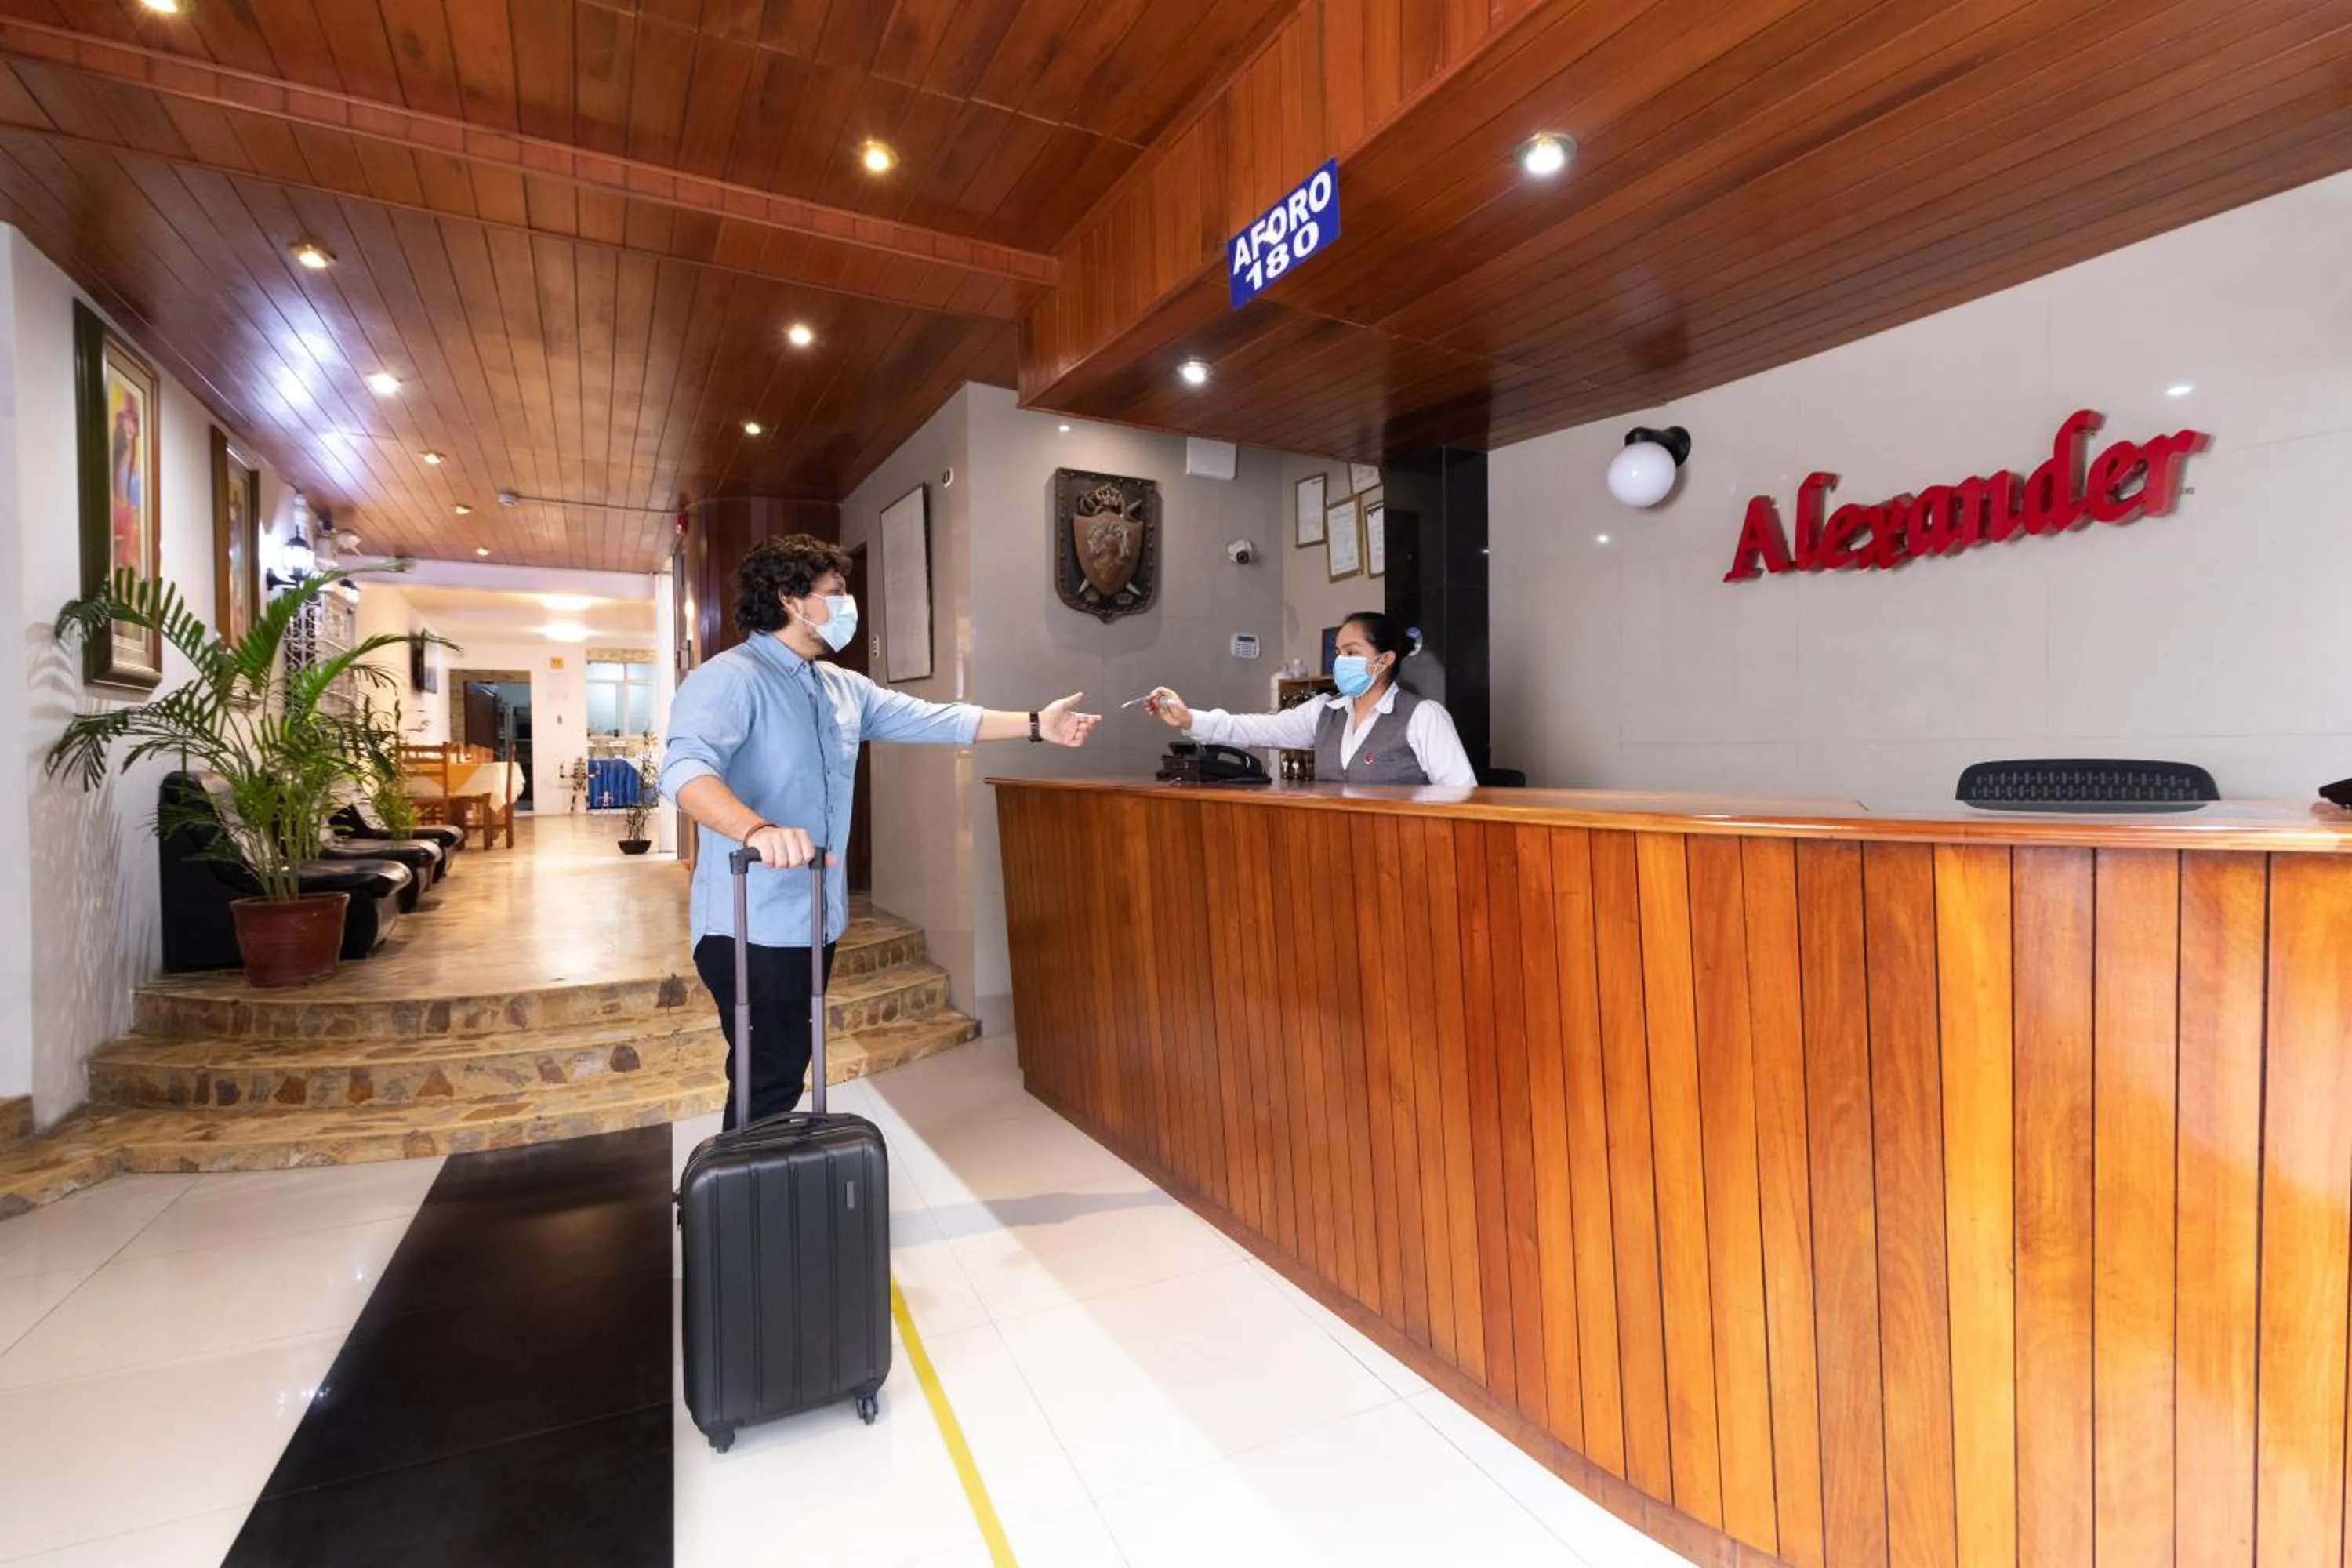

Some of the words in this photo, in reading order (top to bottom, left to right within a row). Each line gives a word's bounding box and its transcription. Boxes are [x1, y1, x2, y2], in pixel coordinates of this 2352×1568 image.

[1233, 171, 1332, 275] AFORO
[1245, 221, 1319, 290] 180
[1723, 408, 2209, 583] Alexander
